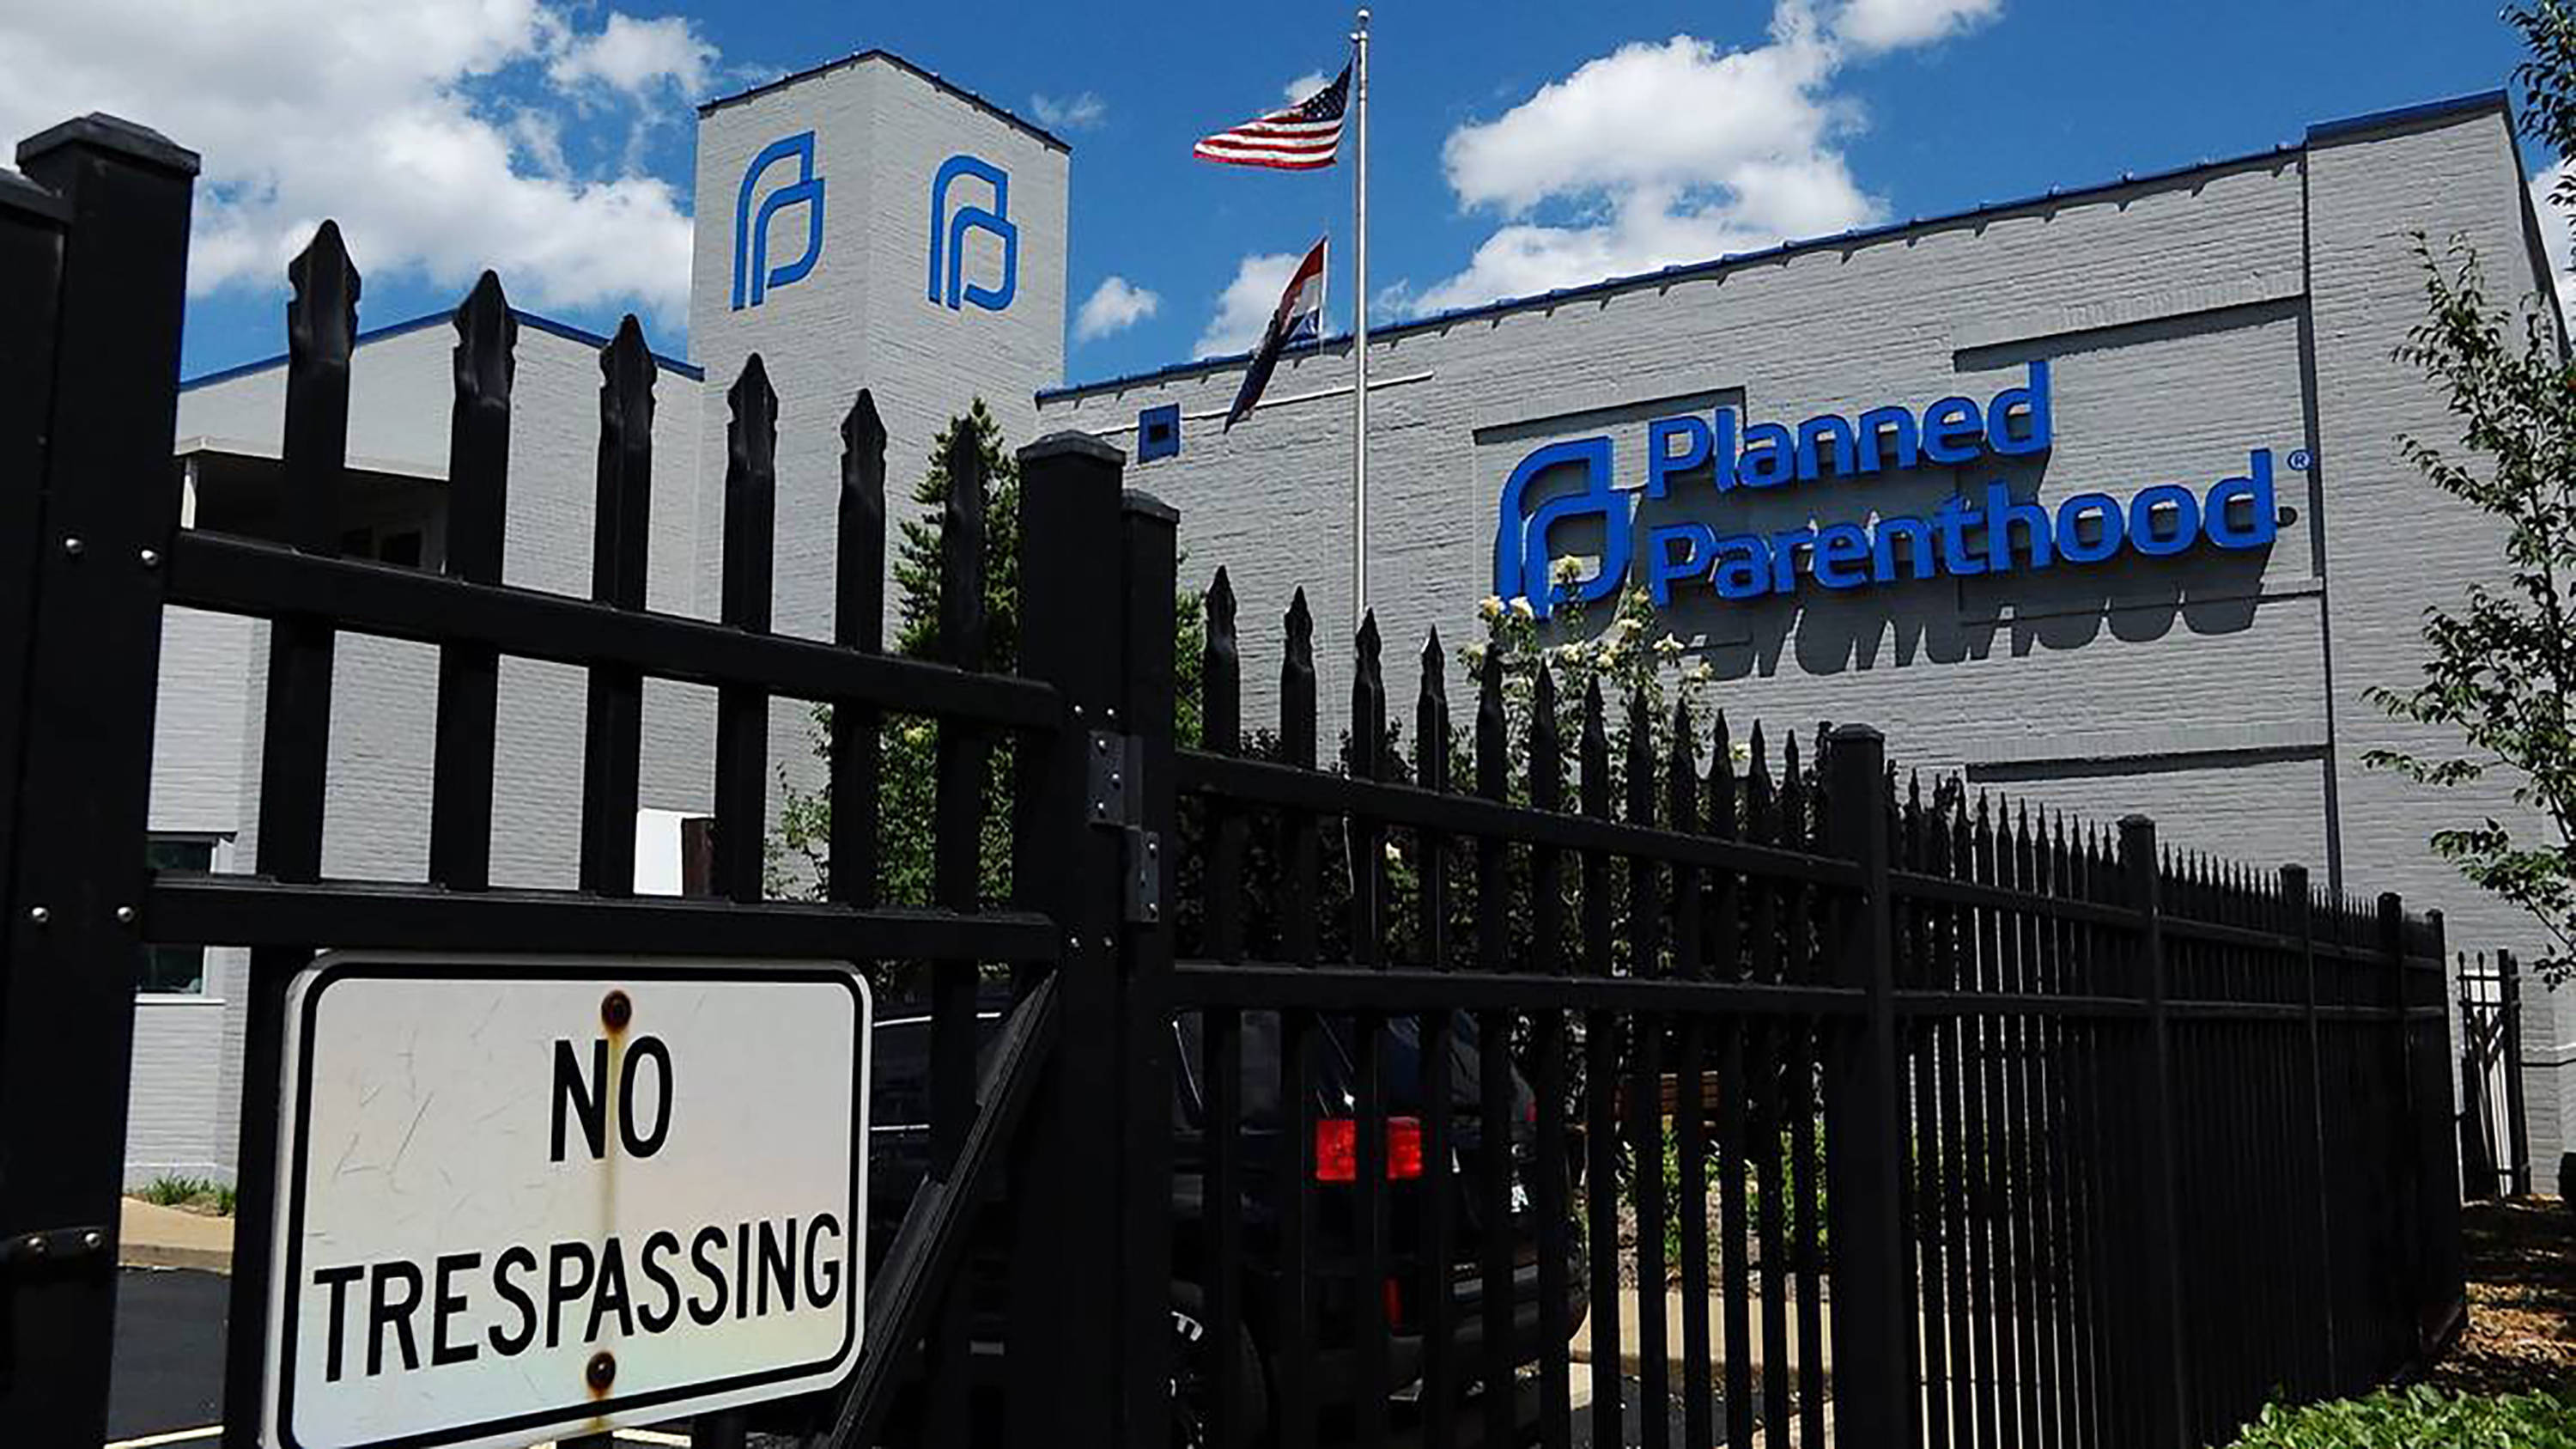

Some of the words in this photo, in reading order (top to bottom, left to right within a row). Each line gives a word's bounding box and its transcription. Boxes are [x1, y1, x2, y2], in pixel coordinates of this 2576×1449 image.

[1646, 359, 2054, 502] Planned
[1646, 447, 2278, 608] Parenthood
[550, 1036, 673, 1162] NO
[313, 1213, 841, 1383] TRESPASSING
